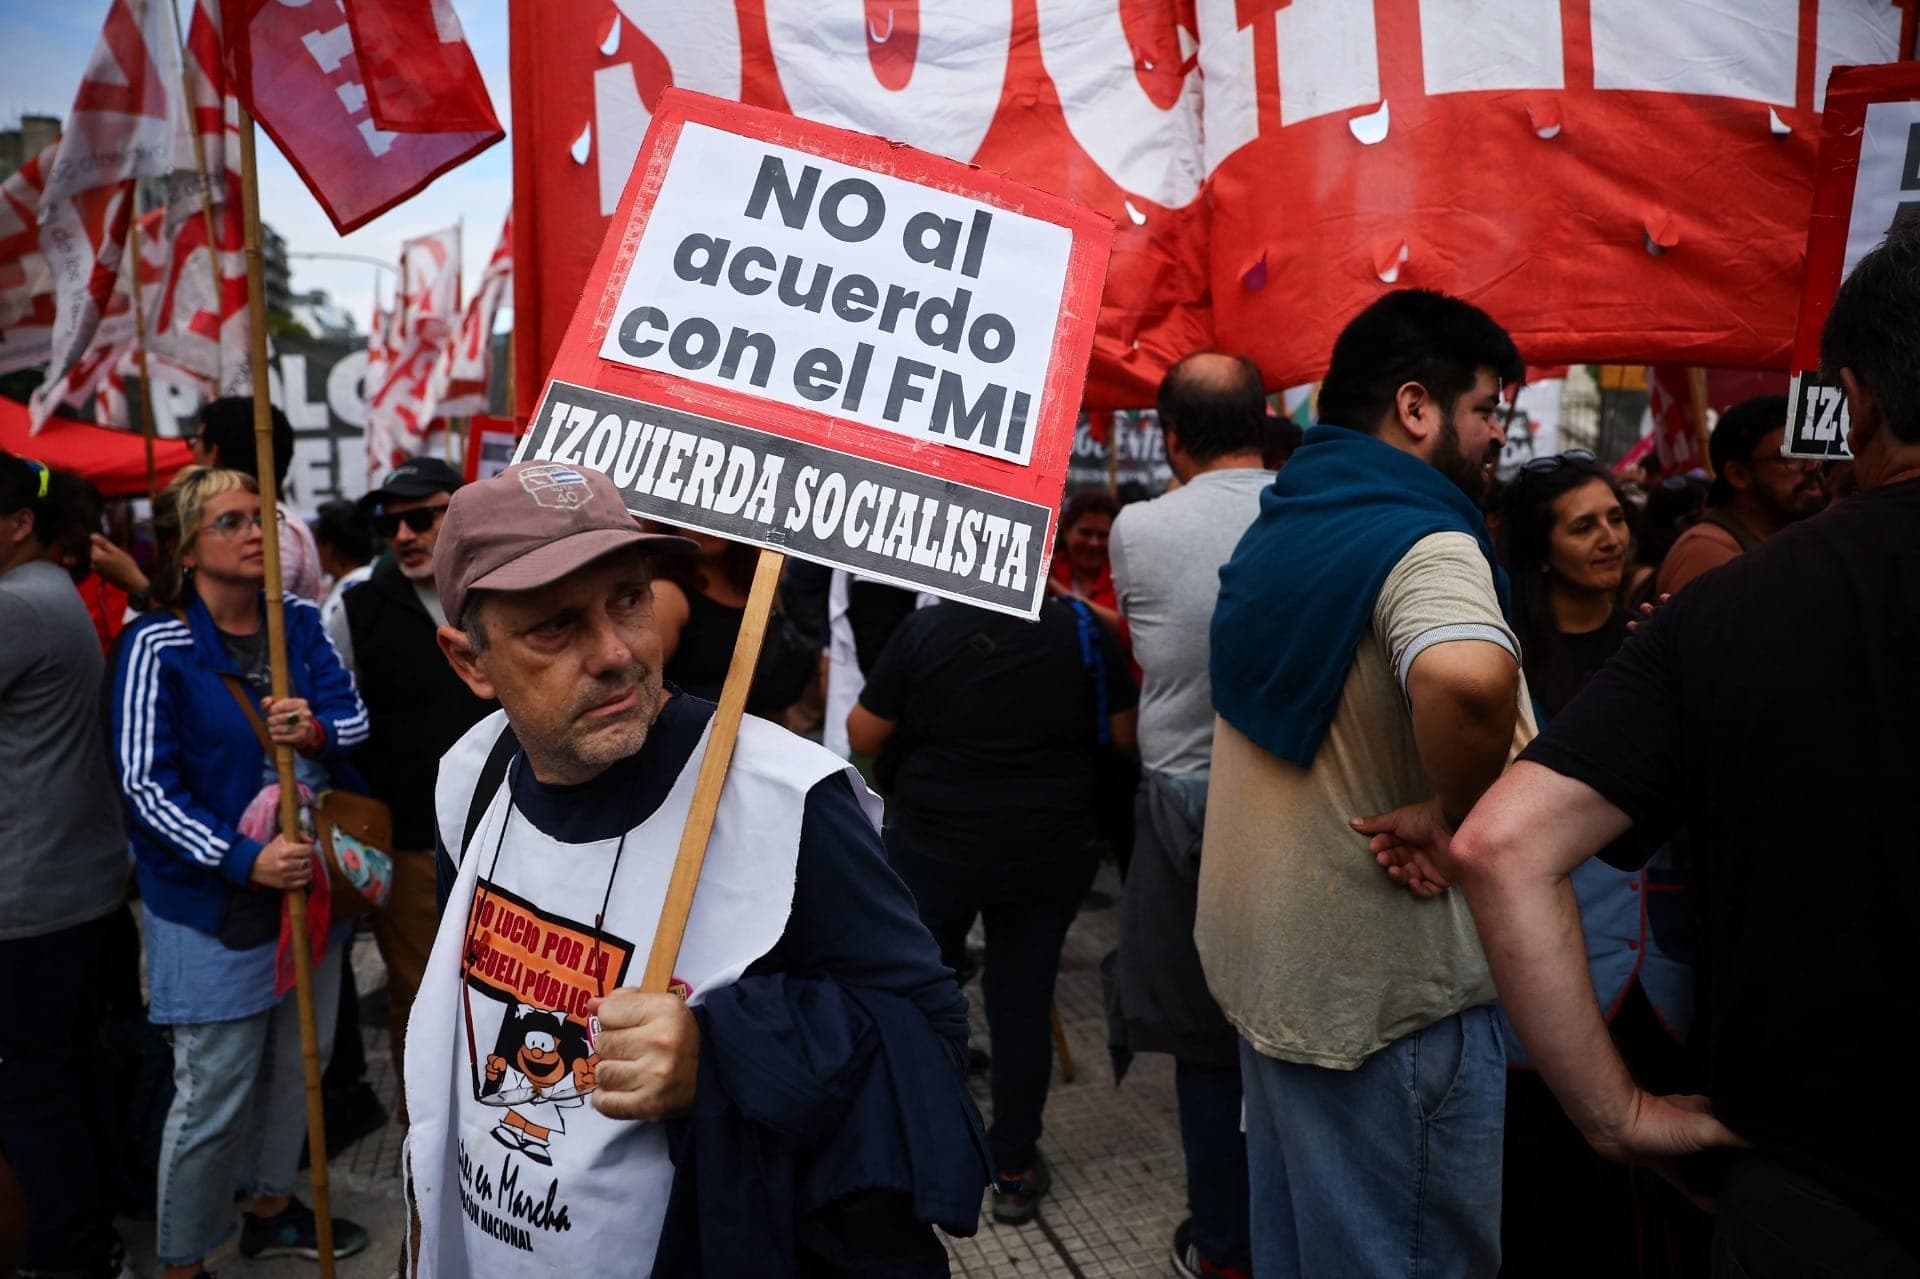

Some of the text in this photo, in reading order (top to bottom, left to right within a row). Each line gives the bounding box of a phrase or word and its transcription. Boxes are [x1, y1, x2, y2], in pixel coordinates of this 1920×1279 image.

[744, 154, 993, 279] NO al
[673, 233, 1016, 363] acuerdo
[618, 306, 776, 388] con
[793, 342, 875, 412] el
[882, 356, 1031, 454] FMI
[784, 465, 1033, 592] SOCIALISTA
[521, 968, 592, 1019] PÚBLIC
[541, 931, 584, 971] POR
[583, 946, 610, 984] LA
[481, 1209, 534, 1252] NACIONAL
[498, 1152, 572, 1233] Marcha
